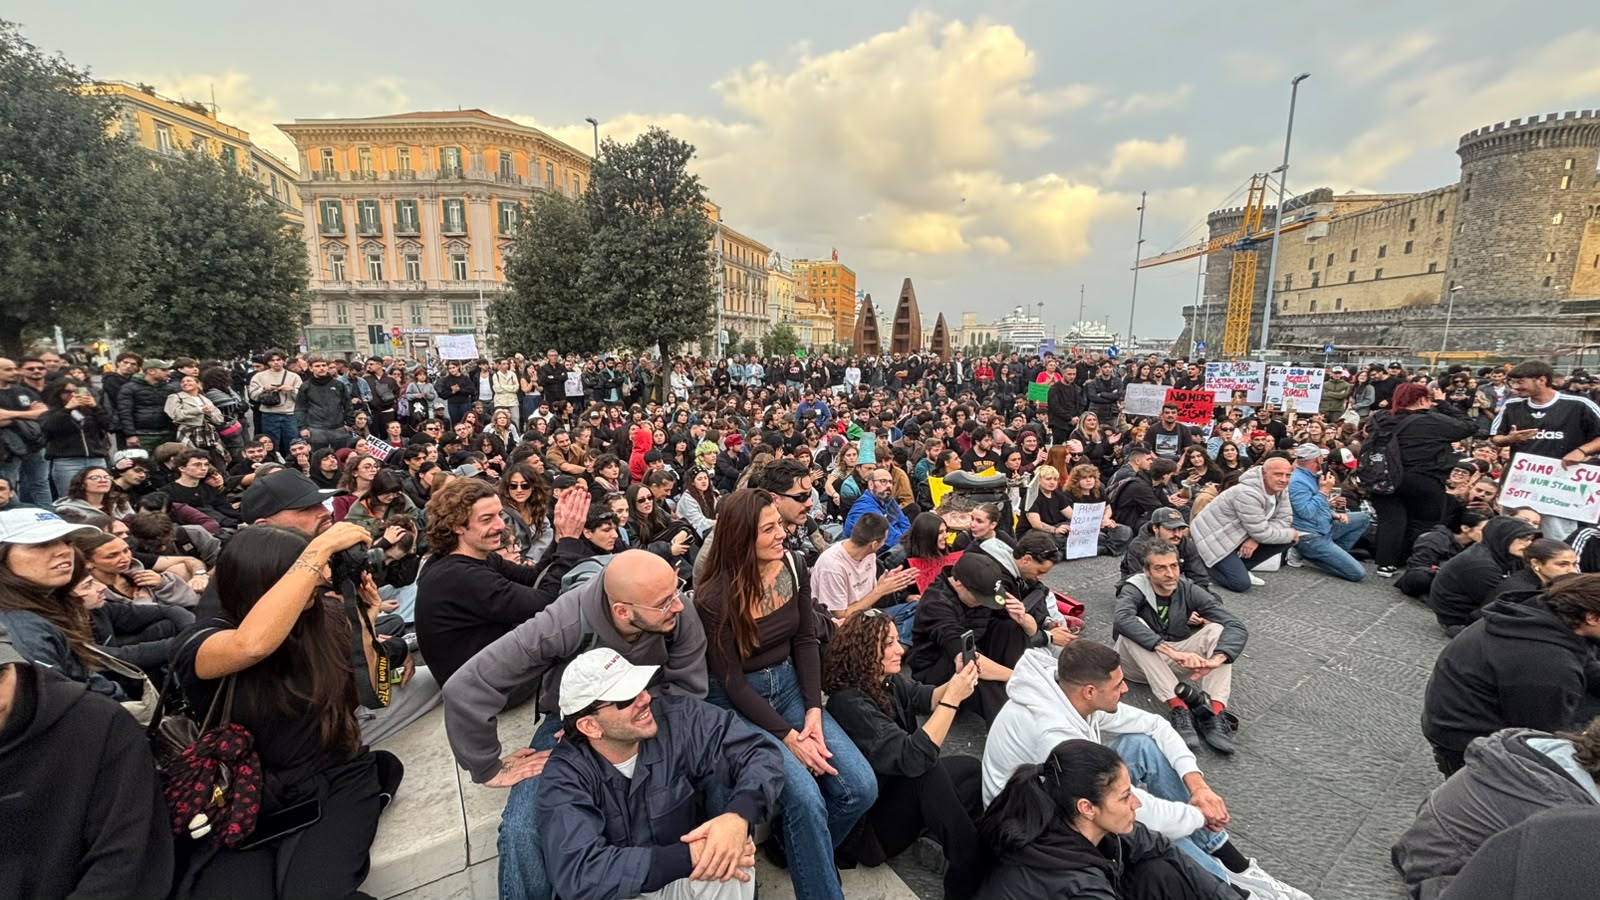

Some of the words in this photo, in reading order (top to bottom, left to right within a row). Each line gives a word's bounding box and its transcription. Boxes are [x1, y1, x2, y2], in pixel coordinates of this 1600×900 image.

[1170, 391, 1187, 401] NO
[1189, 393, 1215, 403] MERCY
[1534, 430, 1564, 439] das
[367, 436, 389, 453] MEGL
[1514, 459, 1553, 475] SIAMO
[1505, 487, 1531, 499] SOTT
[379, 656, 387, 681] Nikon
